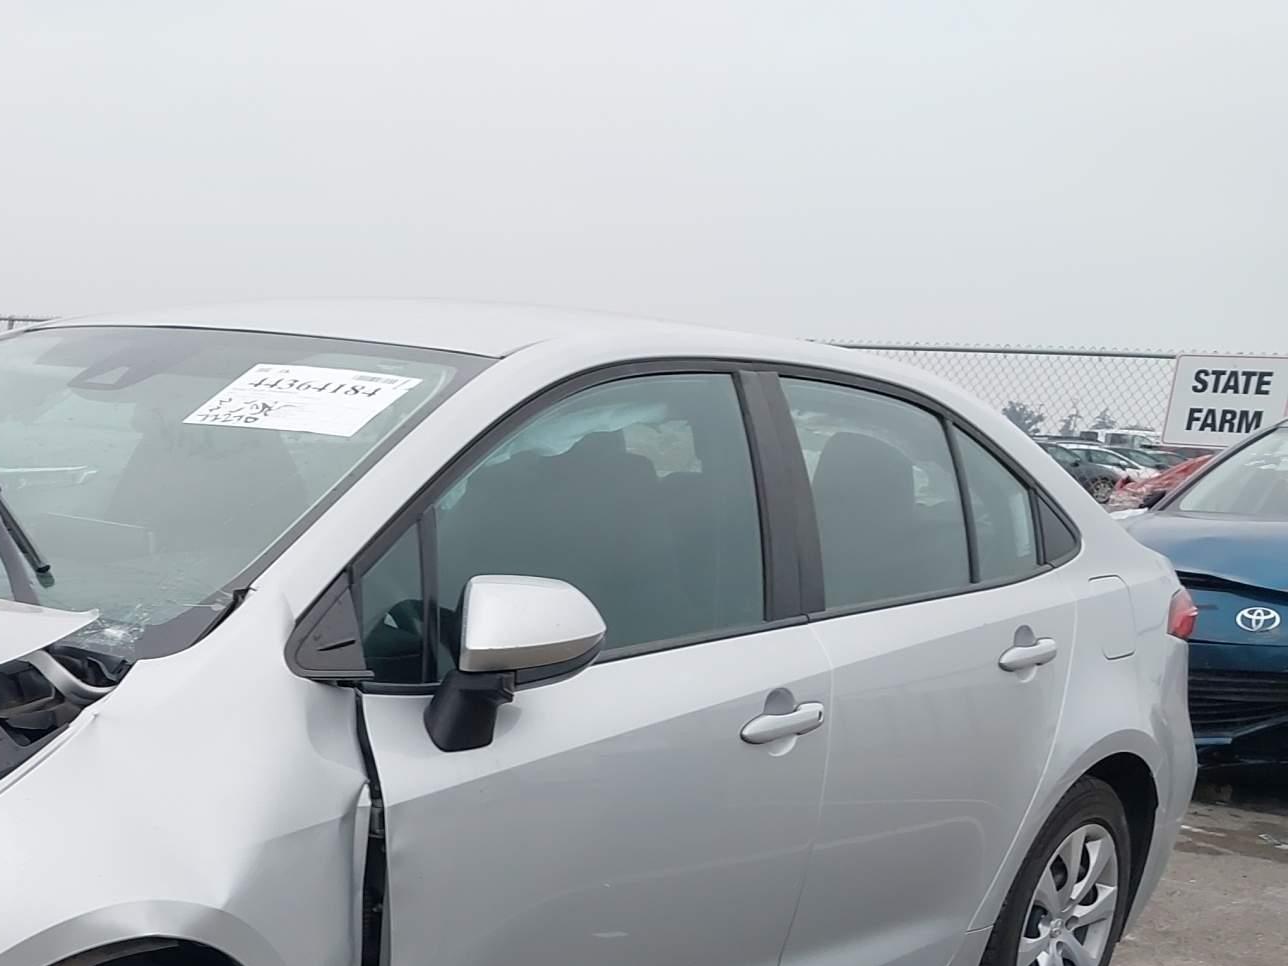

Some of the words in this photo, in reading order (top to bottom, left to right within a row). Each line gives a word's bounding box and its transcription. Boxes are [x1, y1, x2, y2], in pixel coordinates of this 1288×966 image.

[248, 377, 382, 398] 44364184
[1192, 369, 1274, 395] STATE
[1185, 407, 1264, 433] FARM
